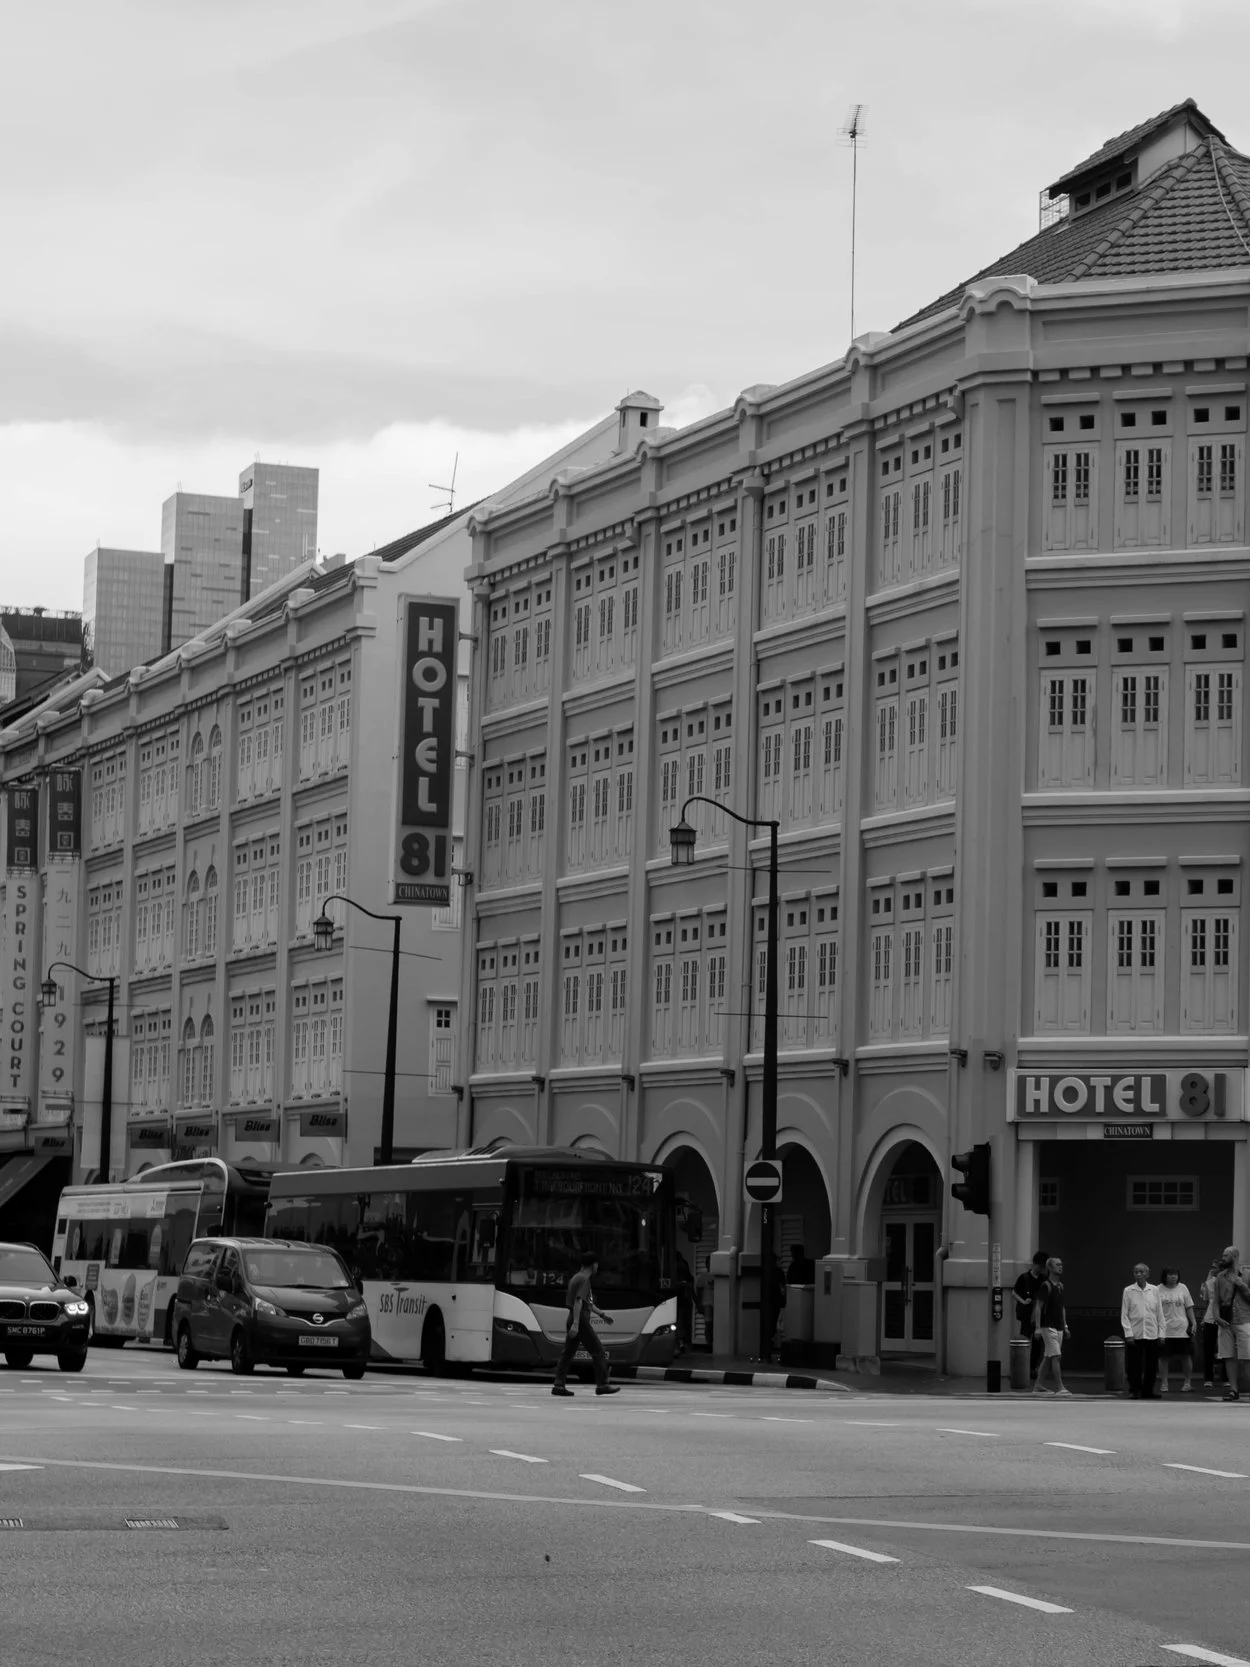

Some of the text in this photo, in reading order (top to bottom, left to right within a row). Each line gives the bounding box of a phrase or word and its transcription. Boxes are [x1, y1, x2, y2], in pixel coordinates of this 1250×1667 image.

[411, 616, 448, 814] HOTEL
[400, 832, 447, 877] 81
[398, 884, 448, 901] CHINATOWN
[10, 885, 27, 1088] SPRING COURT
[1025, 1072, 1227, 1117] HOTEL 81
[244, 1120, 272, 1133] Bliss
[309, 1114, 338, 1127] Bliss
[138, 1128, 165, 1141] Bliss
[183, 1126, 210, 1138] Bliss
[1103, 1126, 1151, 1137] CHINATOWN
[542, 1272, 564, 1286] 124
[379, 1287, 428, 1317] SBS Transit
